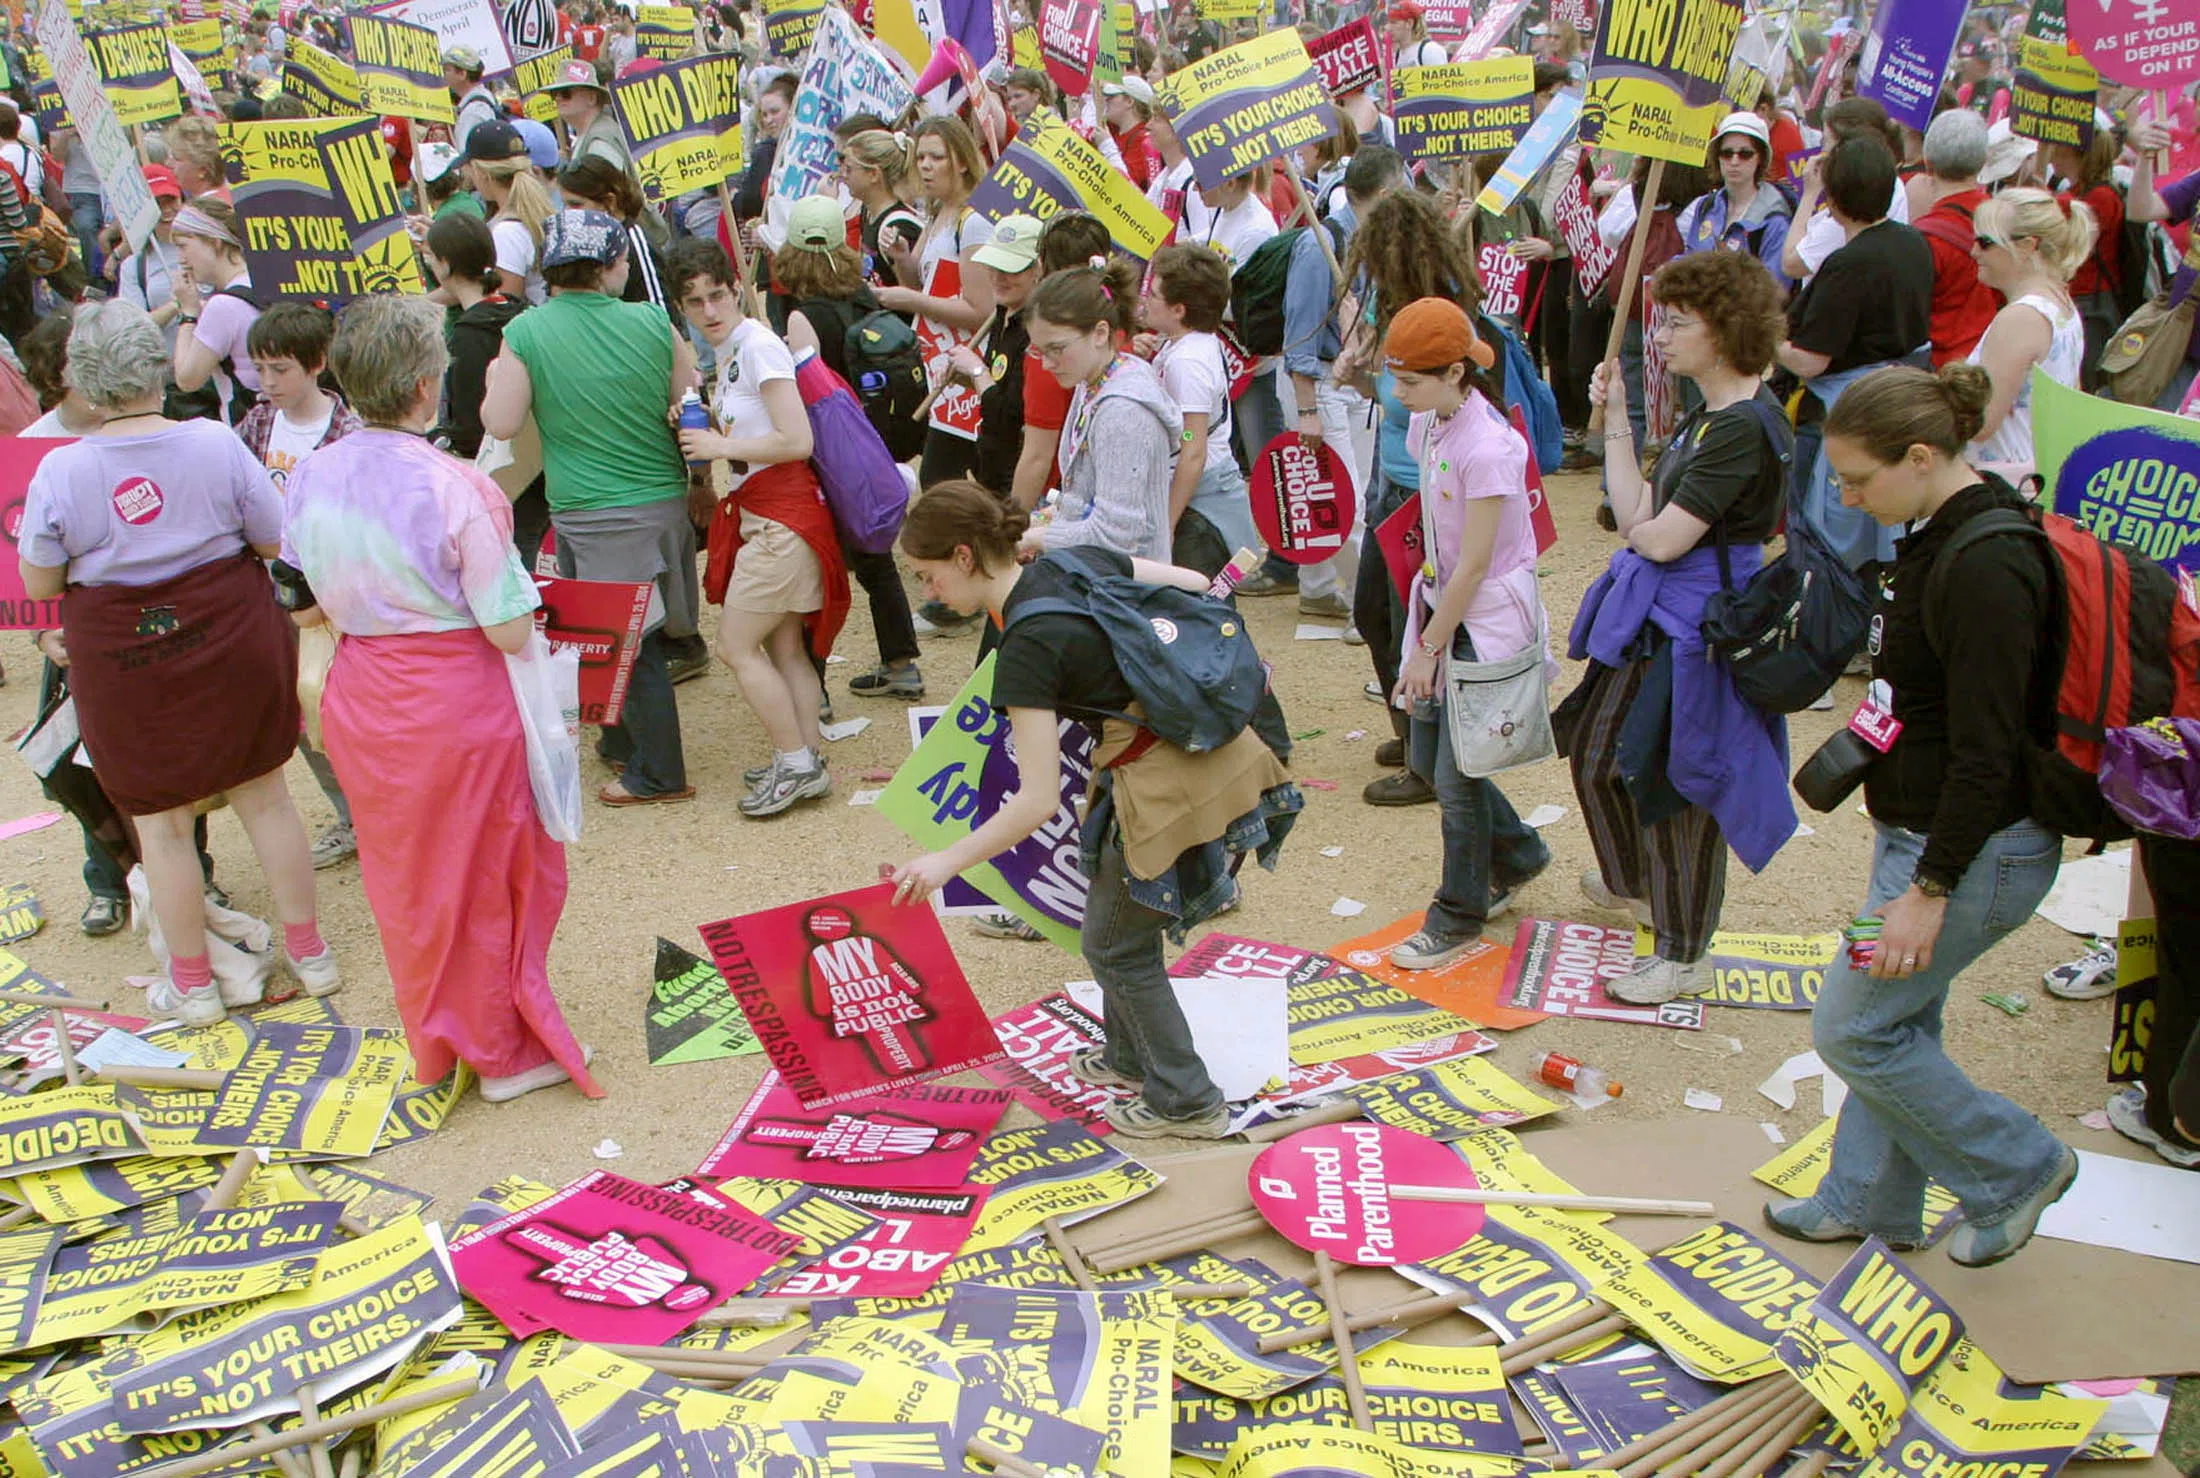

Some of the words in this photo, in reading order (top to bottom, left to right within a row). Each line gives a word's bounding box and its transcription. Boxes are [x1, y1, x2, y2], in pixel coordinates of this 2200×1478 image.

[1046, 4, 1066, 25] FOR
[1551, 3, 1585, 17] SAVES
[351, 17, 387, 66] WHO
[441, 19, 471, 37] April
[1606, 0, 1677, 68] WHO
[2094, 36, 2118, 51] AS
[2124, 31, 2140, 46] IF
[2143, 21, 2196, 41] YOUR
[515, 61, 540, 95] WHO
[1193, 51, 1245, 82] NARAL
[1199, 61, 1263, 93] Pro-Choice
[1263, 47, 1304, 68] America
[1336, 54, 1374, 84] ALL
[1421, 68, 1464, 80] NARAL
[1422, 77, 1481, 91] Pro-Choice
[1484, 72, 1529, 84] America
[2140, 60, 2170, 76] ON
[2177, 56, 2196, 70] IT
[616, 73, 684, 142] WHO
[1186, 122, 1227, 158] IT'S
[1222, 102, 1276, 138] YOUR
[1271, 82, 1325, 122] CHOICE
[1398, 115, 1427, 135] IT'S
[1428, 110, 1470, 132] YOUR
[1473, 104, 1532, 127] CHOICE
[1632, 102, 1673, 125] NARAL
[2051, 97, 2093, 123] CHOICE
[1269, 113, 1327, 150] THEIRS.
[1459, 130, 1517, 151] THEIRS.
[1062, 137, 1108, 184] NARAL
[992, 160, 1033, 200] IT'S
[1054, 149, 1113, 206] Pro-Choice
[1112, 203, 1156, 246] America
[1554, 174, 1582, 225] STOP
[1565, 200, 1584, 224] THE
[244, 216, 293, 251] IT'S
[1564, 206, 1599, 257] WAR
[1479, 247, 1527, 276] STOP
[1580, 238, 1595, 262] ON
[279, 260, 339, 295] ...NOT
[1486, 271, 1514, 293] THE
[2, 601, 36, 626] NO
[704, 922, 744, 958] NO
[812, 935, 881, 986] MY
[829, 974, 893, 1007] BODY
[832, 1005, 861, 1022] is
[862, 990, 914, 1013] not
[721, 958, 828, 1101] TRESPASSING
[834, 1004, 928, 1038] PUBLIC
[1018, 1008, 1094, 1054] ALL
[1405, 1019, 1472, 1041] NARAL
[295, 1029, 336, 1053] IT'S
[873, 1026, 915, 1071] PROPERTY
[1290, 1032, 1362, 1052] America
[209, 1069, 269, 1131] THEIRS.
[803, 1097, 835, 1112] MARCH
[834, 1092, 850, 1104] FOR
[848, 1083, 891, 1100] WOMEN'S
[890, 1076, 916, 1091] LIVES
[941, 1062, 968, 1075] APRIL
[245, 1090, 302, 1145] CHOICE
[321, 1109, 352, 1150] America
[753, 1125, 823, 1142] PROPERTY
[880, 1126, 938, 1155] MY
[1047, 1138, 1105, 1165] IT'S
[969, 1151, 1055, 1186] YOUR
[1770, 1153, 1822, 1186] America
[587, 1175, 752, 1246] TRESPASSING
[990, 1182, 1096, 1225] Pro-Choice
[1026, 1189, 1110, 1215] NARAL
[1300, 1146, 1348, 1240] Planned
[1342, 1125, 1397, 1264] Parenthood
[203, 1204, 306, 1232] ...NOT
[162, 1232, 250, 1264] YOUR
[259, 1223, 324, 1249] IT'S
[517, 1227, 582, 1261] PROPERTY
[320, 1235, 419, 1283] America
[538, 1230, 625, 1283] PUBLIC
[611, 1259, 689, 1306] MY
[1839, 1251, 1954, 1377] WHO
[126, 1375, 199, 1412] IT'S
[203, 1324, 302, 1387] YOUR
[306, 1265, 442, 1342] CHOICE
[1654, 1311, 1737, 1366] America
[166, 1370, 276, 1424] ...NOT
[286, 1312, 423, 1382] THEIRS.
[1133, 1338, 1161, 1420] NARAL
[1382, 1357, 1491, 1376] America
[1106, 1337, 1133, 1461] Pro-Choice
[1250, 1389, 1351, 1419] YOUR
[1365, 1395, 1503, 1424] CHOICE
[55, 1419, 135, 1462] IT'S
[1970, 1416, 2082, 1432] America
